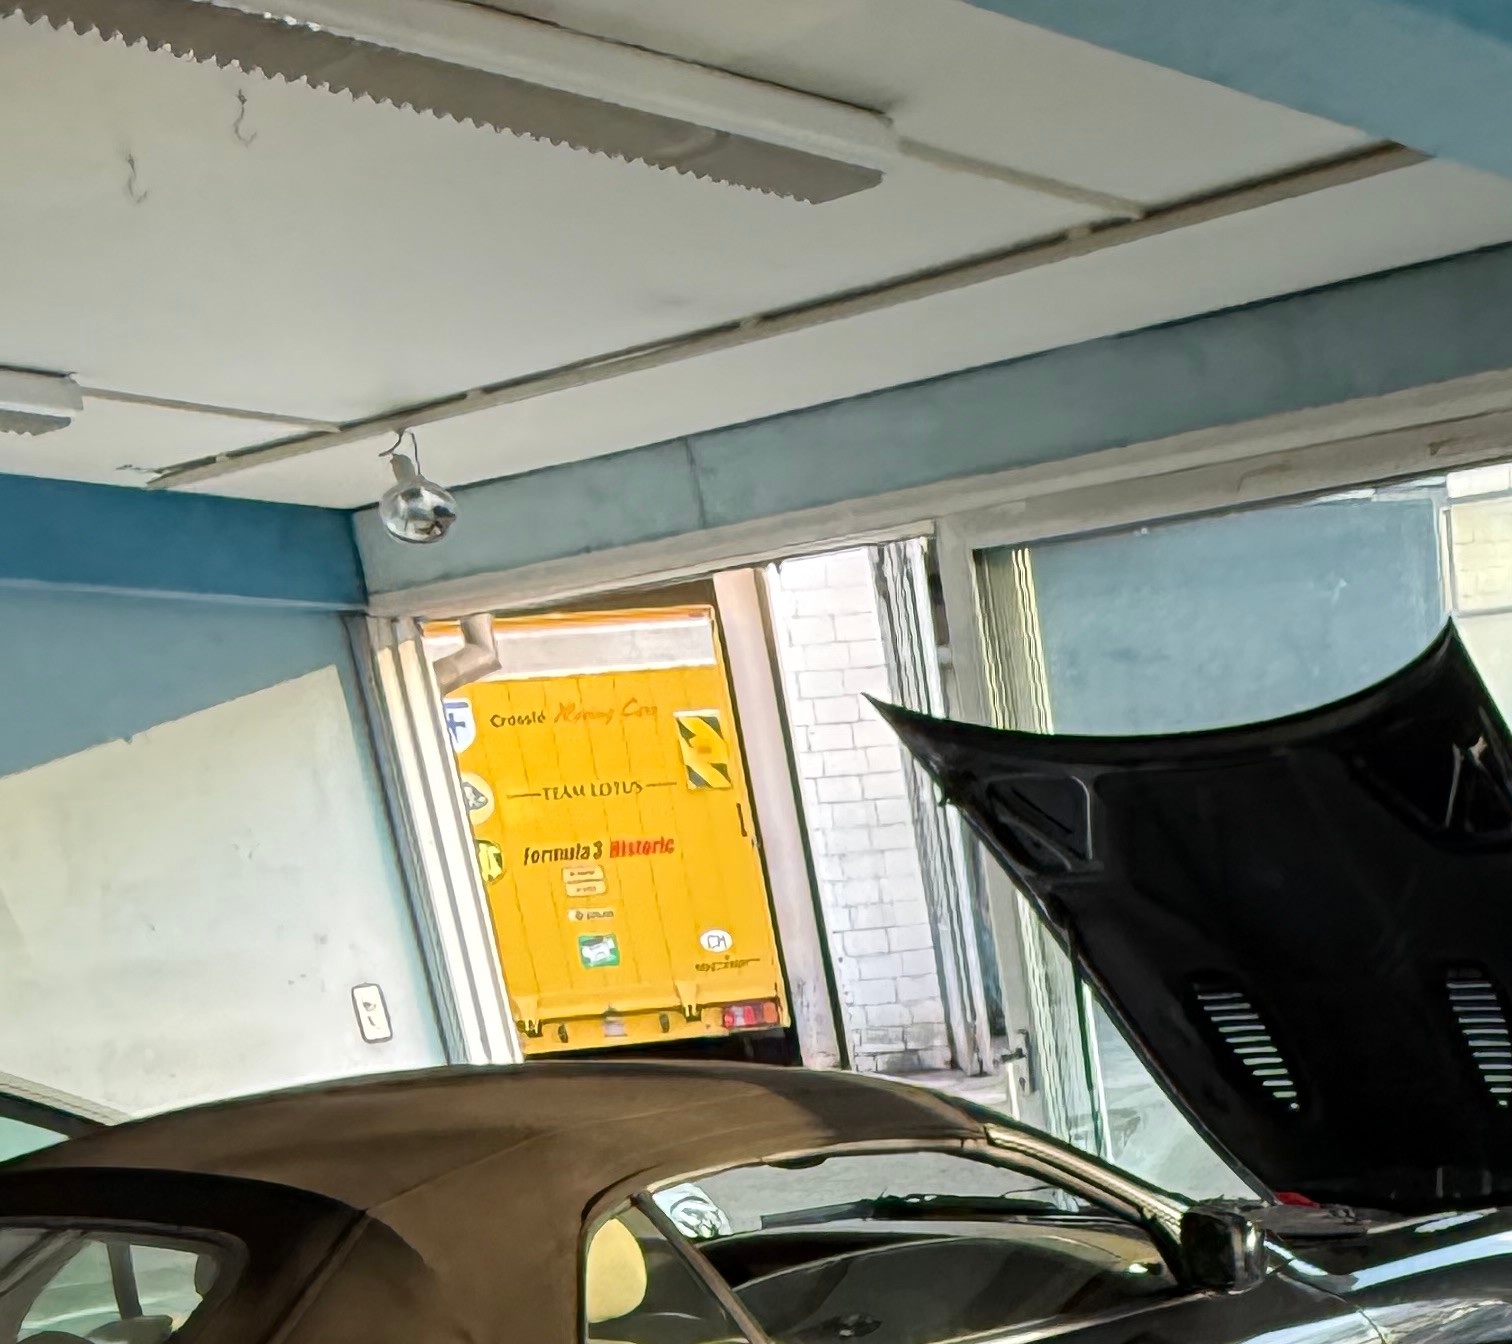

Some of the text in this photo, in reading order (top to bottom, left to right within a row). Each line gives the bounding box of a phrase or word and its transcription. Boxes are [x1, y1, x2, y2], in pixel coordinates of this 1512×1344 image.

[543, 781, 644, 801] TEAM LOTUS
[523, 836, 676, 867] Formula 3 Historic
